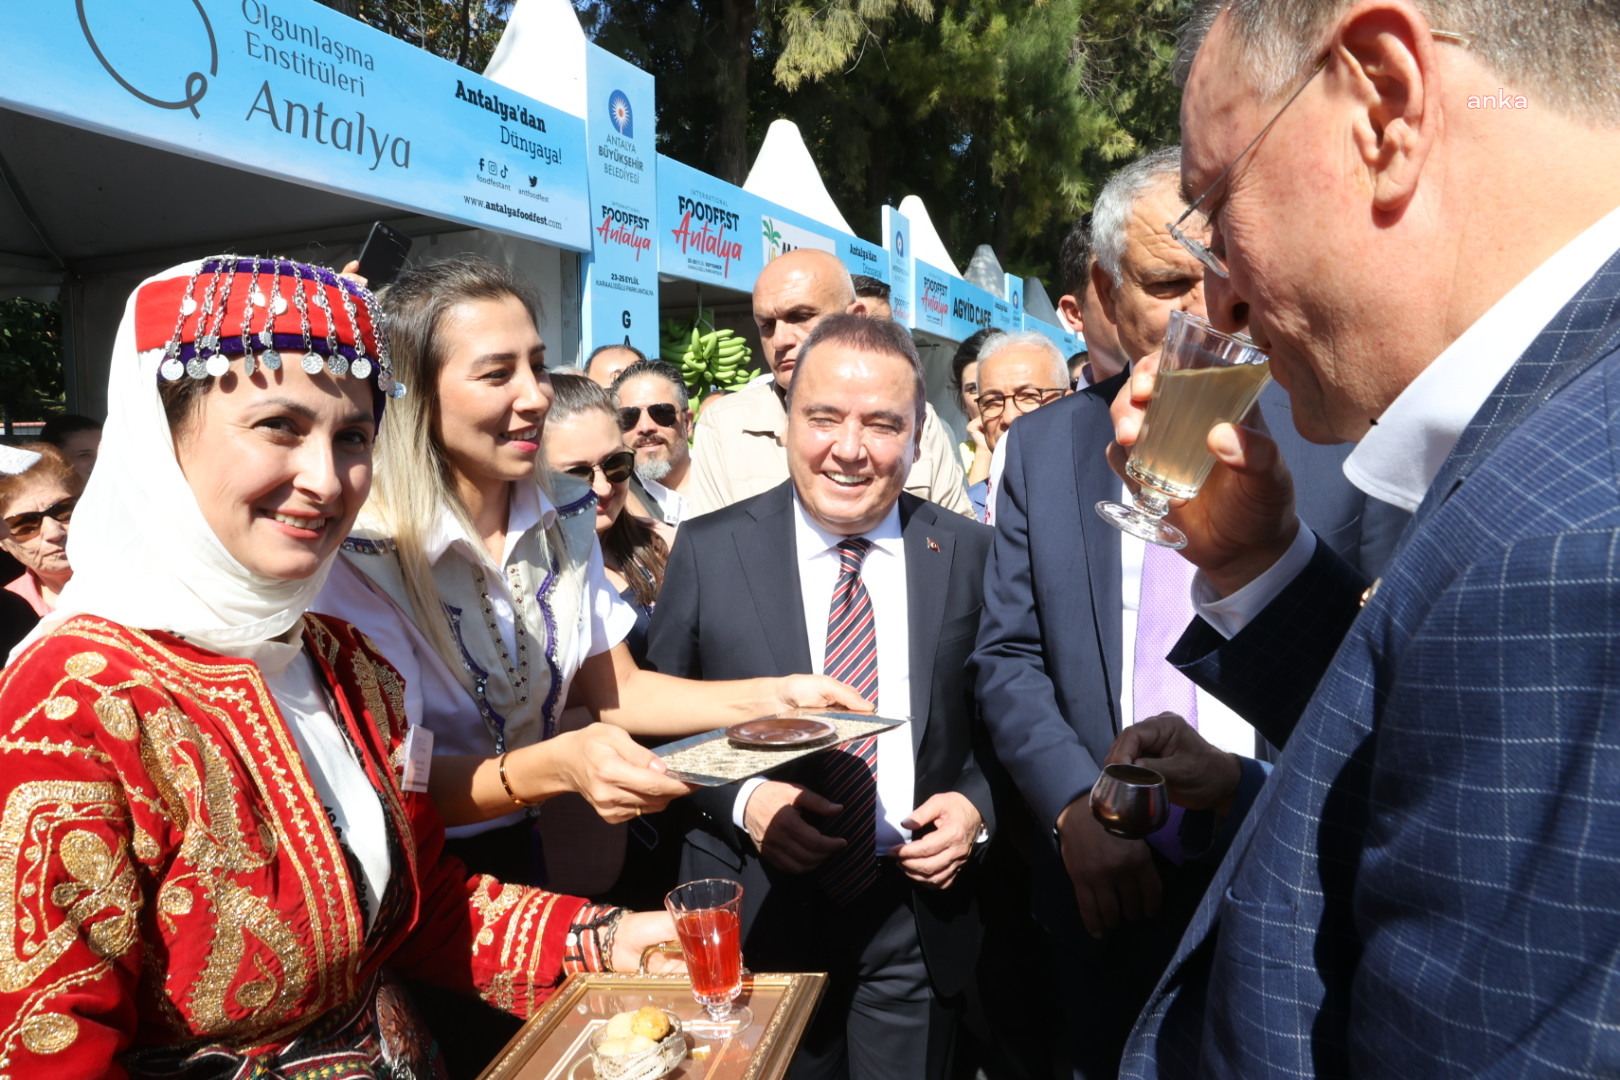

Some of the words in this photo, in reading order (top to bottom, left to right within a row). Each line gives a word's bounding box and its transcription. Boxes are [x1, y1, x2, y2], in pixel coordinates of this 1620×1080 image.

[242, 0, 374, 71] Olgunlaşma
[244, 30, 364, 98] Enstitüleri
[245, 80, 411, 171] Antalya
[455, 79, 547, 133] Antalya'dan
[500, 125, 562, 166] Dünyaya!
[606, 134, 637, 154] ANTALYA
[463, 195, 562, 230] www.antalyafoodfest.com
[602, 205, 649, 231] FOODFEST
[678, 195, 740, 232] FOODFEST
[596, 215, 651, 262] Antalya
[671, 210, 742, 279] Antalya
[975, 305, 992, 328] CAFE
